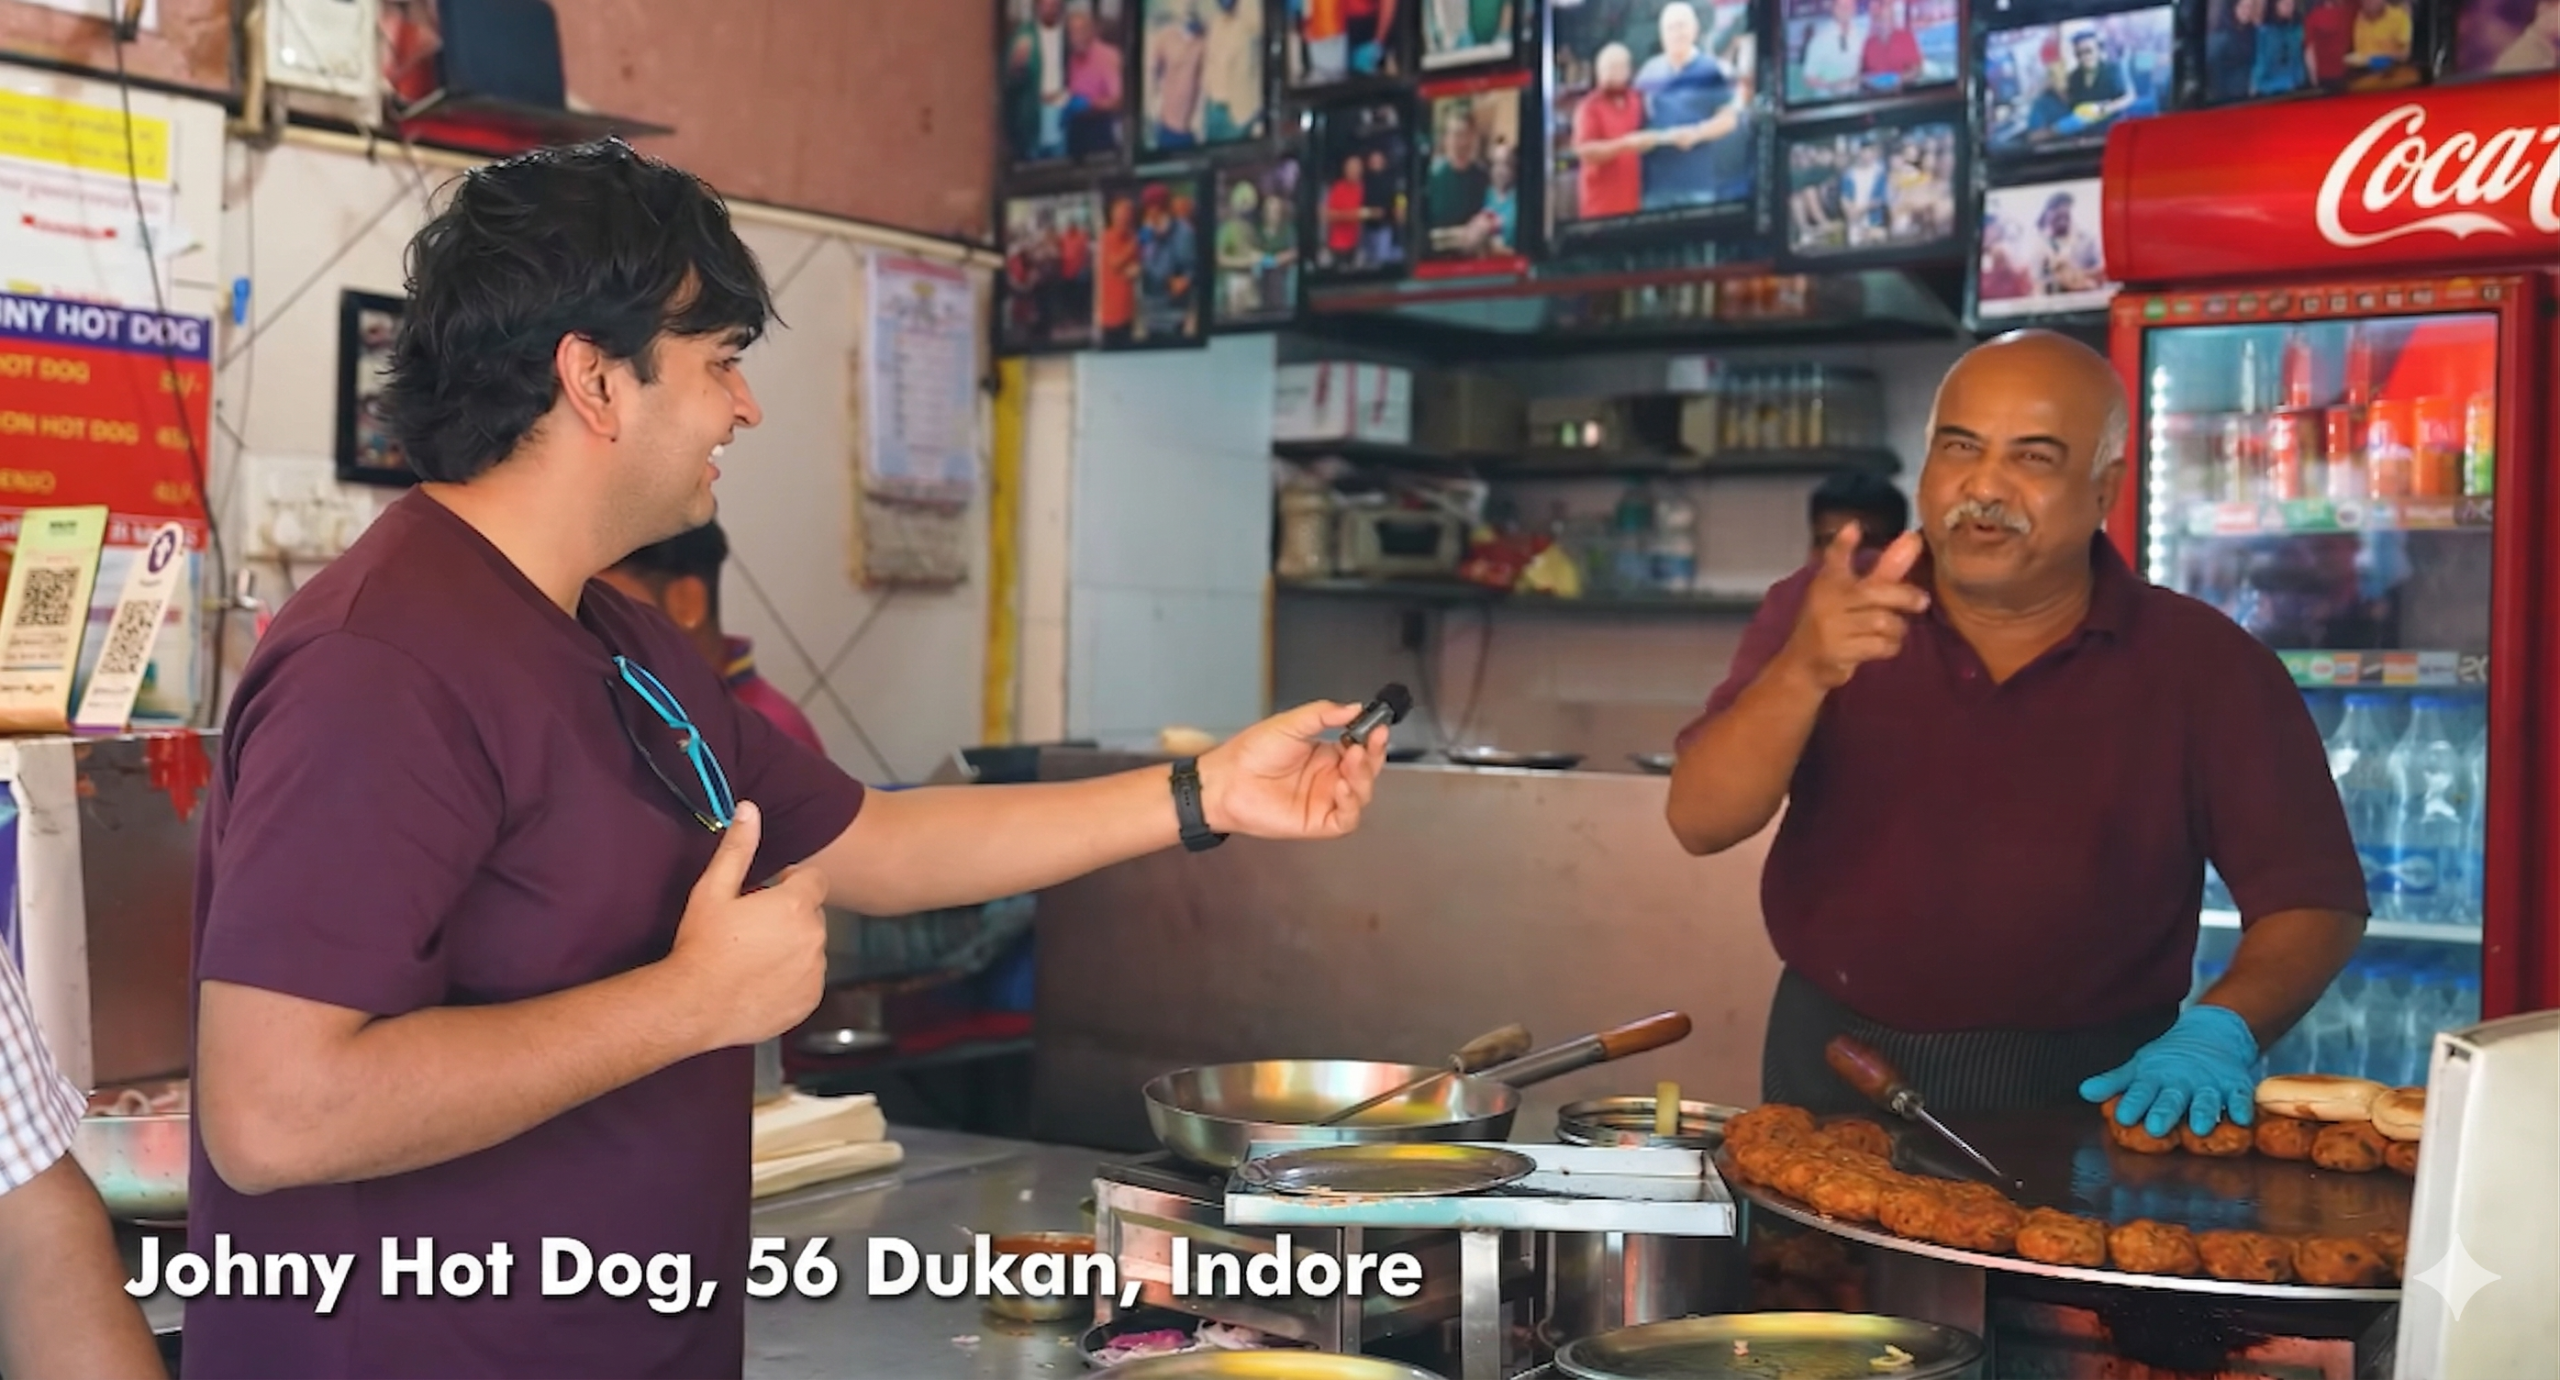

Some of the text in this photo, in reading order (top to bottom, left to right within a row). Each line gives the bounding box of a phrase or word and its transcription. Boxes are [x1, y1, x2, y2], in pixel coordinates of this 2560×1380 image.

[0, 297, 202, 351] NY HOT DOG
